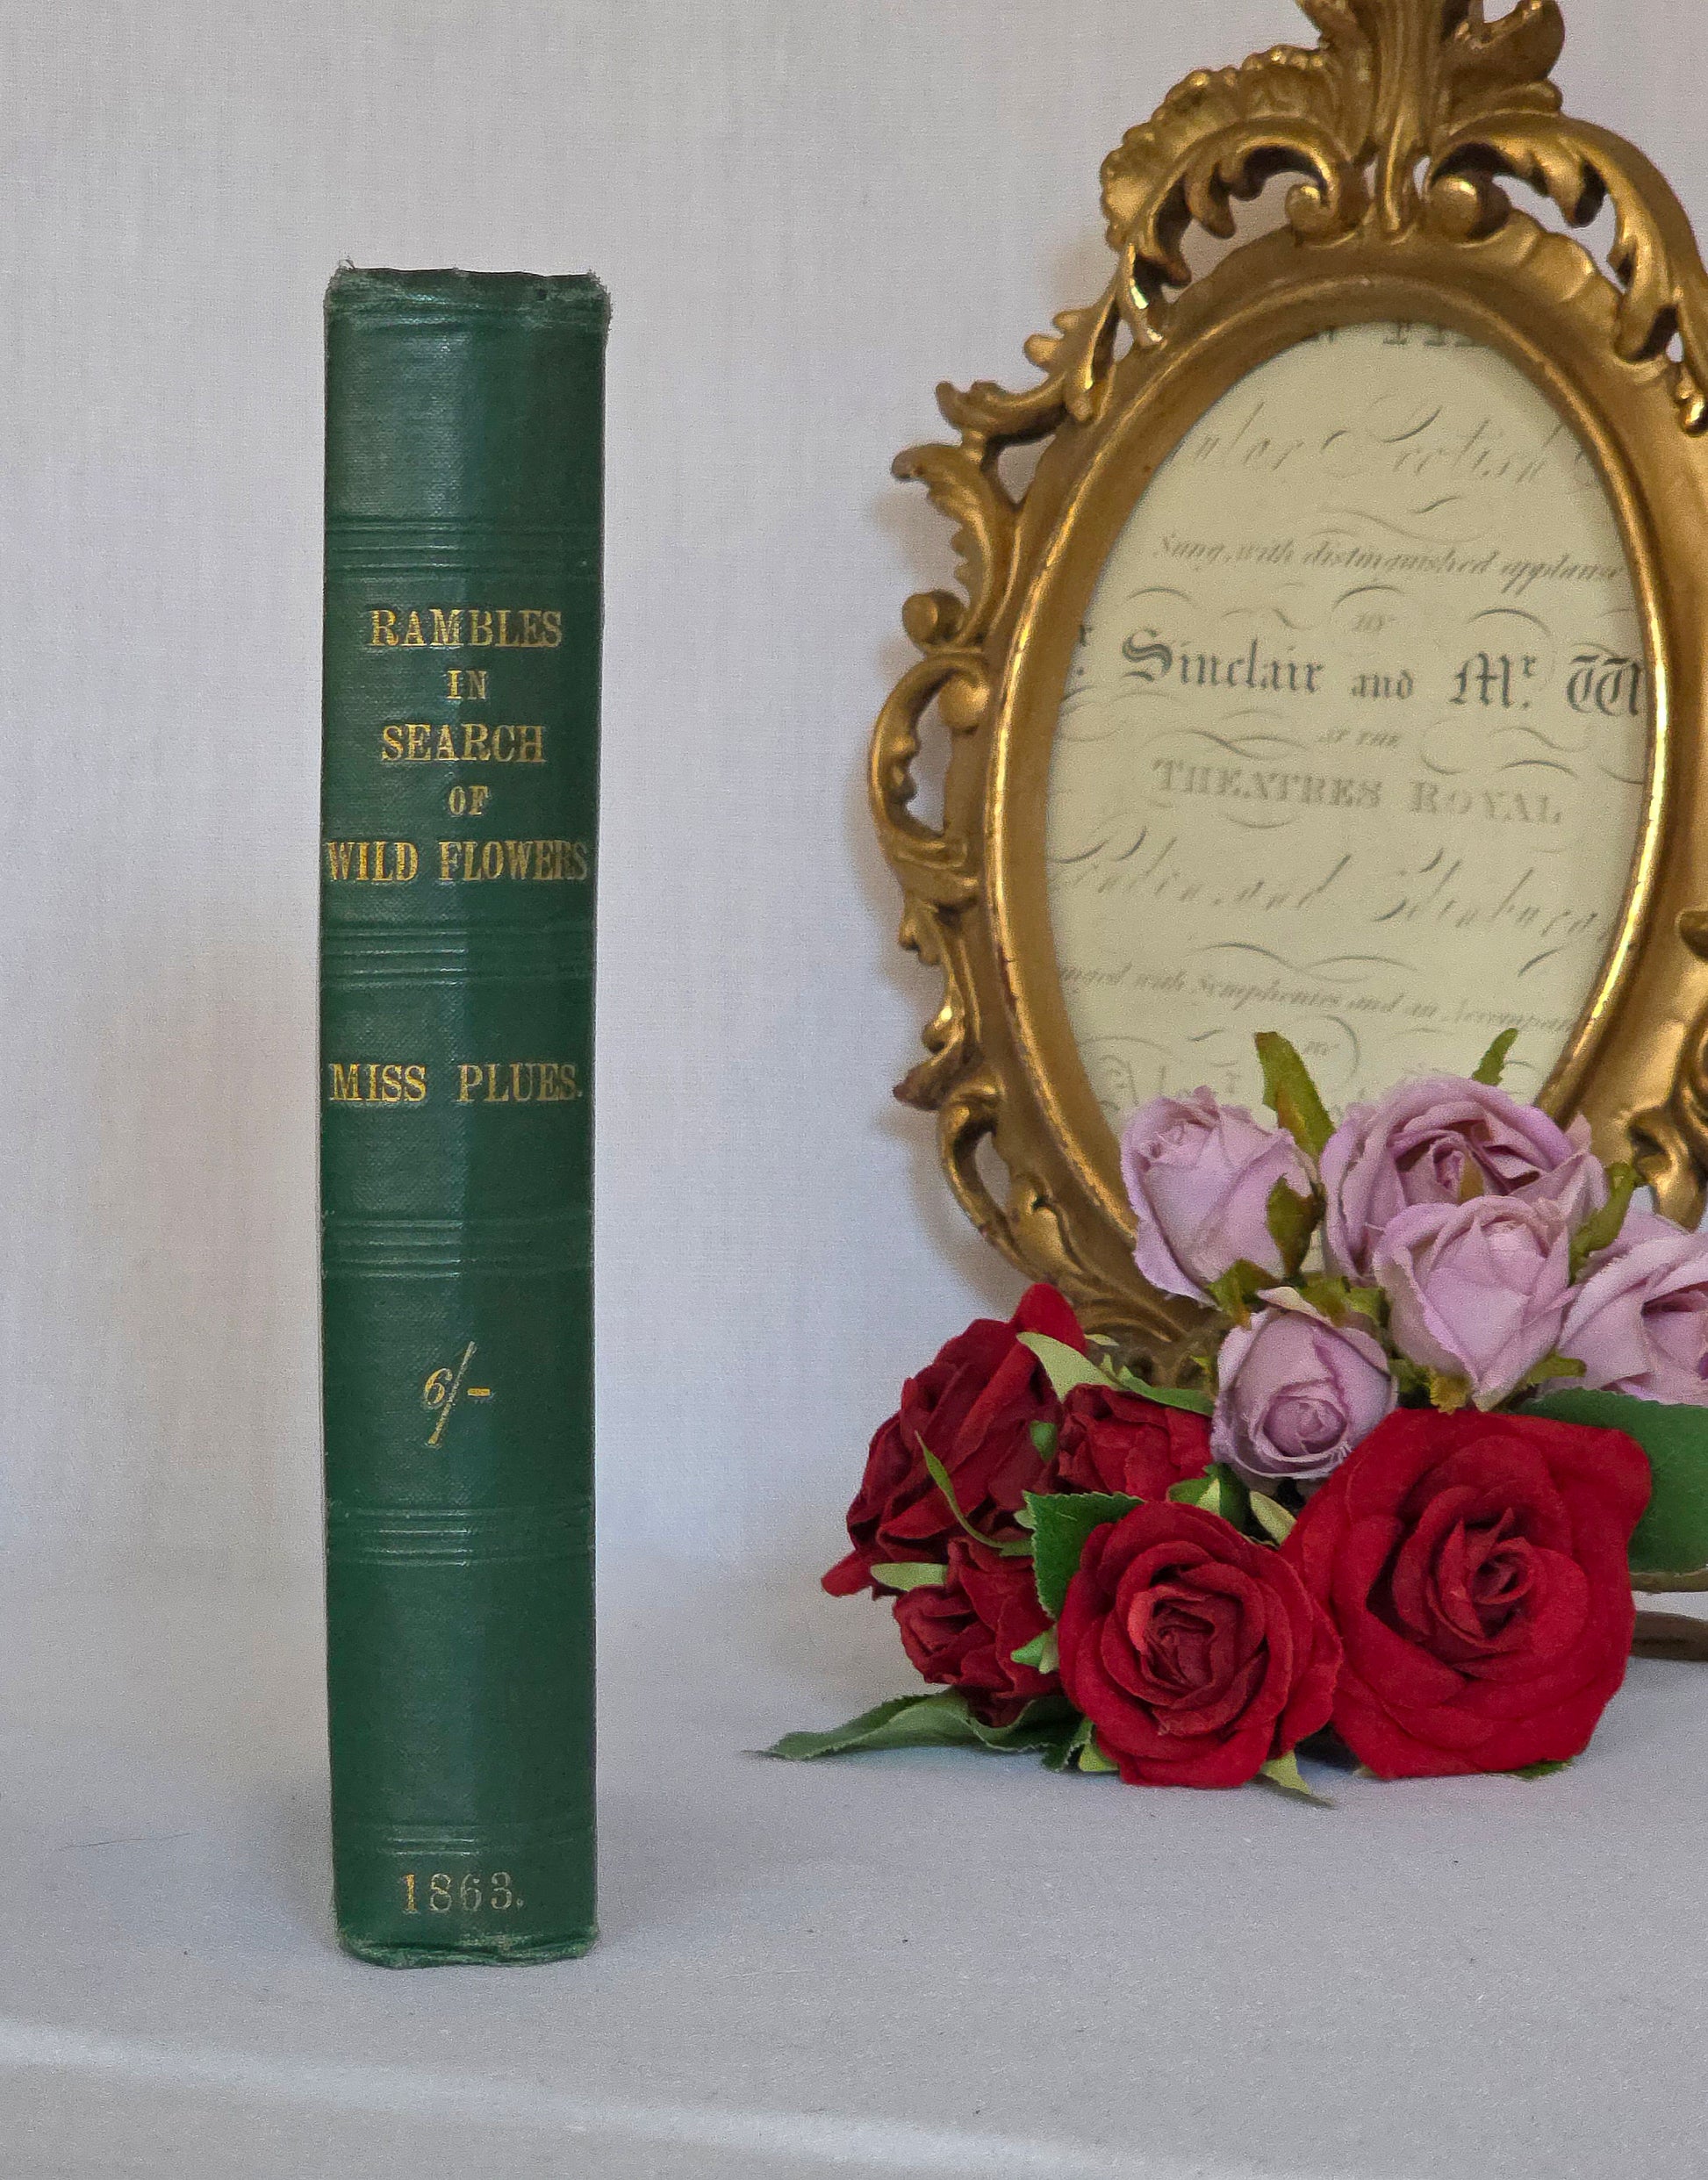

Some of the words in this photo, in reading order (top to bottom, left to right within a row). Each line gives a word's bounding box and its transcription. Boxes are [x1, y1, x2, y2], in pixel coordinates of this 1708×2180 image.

[370, 608, 563, 649] RAMBLES
[447, 669, 487, 700] IN
[1122, 627, 1325, 693] Sinclair
[1350, 669, 1415, 700] and
[380, 723, 547, 764] SEARCH
[448, 785, 491, 816] OF
[1152, 758, 1384, 808] THEATRES
[325, 840, 420, 882] WILD
[438, 839, 589, 882] FLOWERS
[329, 1061, 428, 1103] MISS
[454, 1062, 585, 1103] PLUES.
[401, 1870, 526, 1914] 1863.
